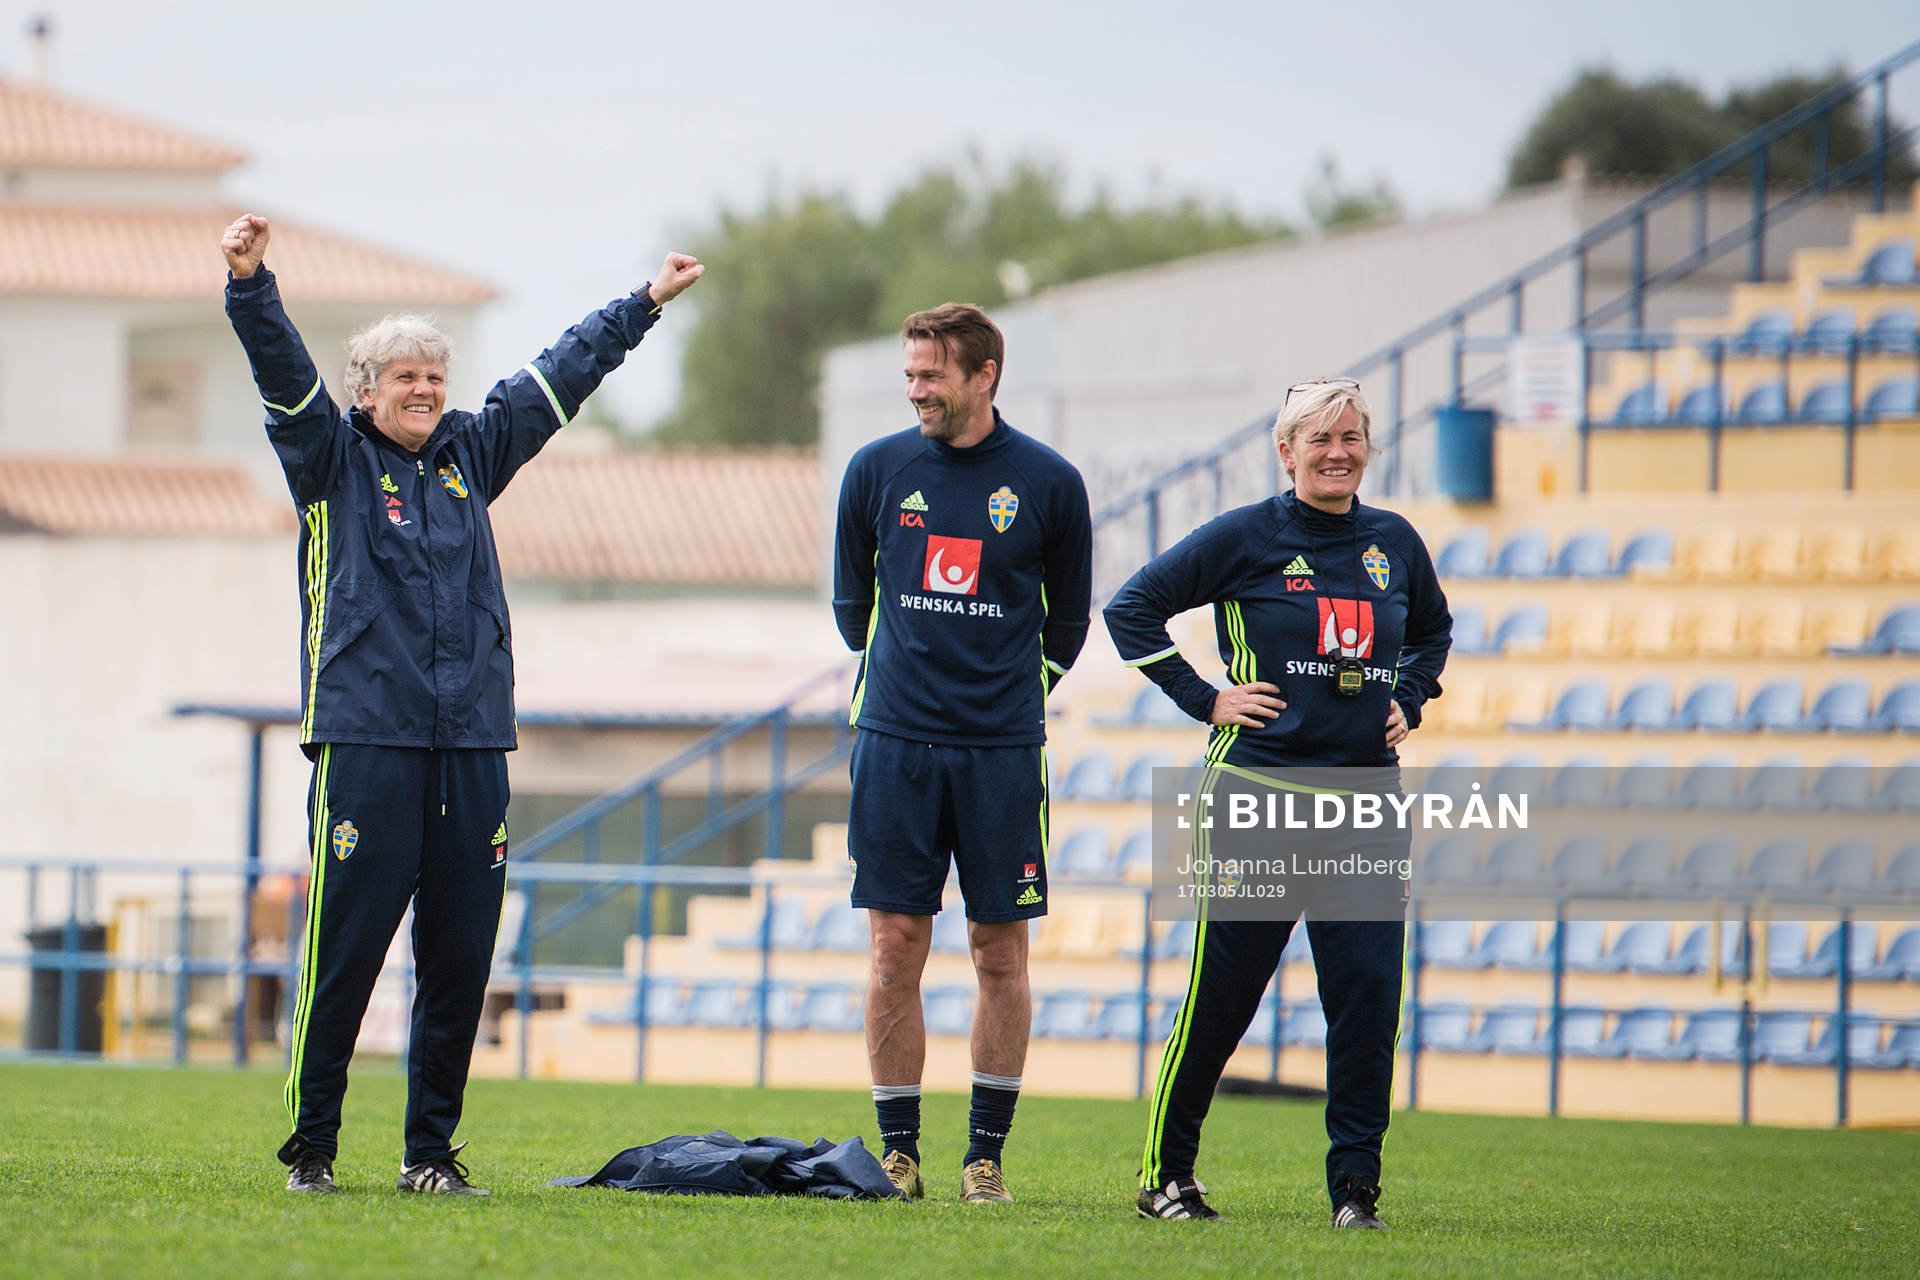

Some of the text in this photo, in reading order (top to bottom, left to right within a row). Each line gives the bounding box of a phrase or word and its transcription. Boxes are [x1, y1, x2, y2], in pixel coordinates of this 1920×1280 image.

[900, 501, 929, 512] adidas
[900, 512, 926, 528] ICA
[1283, 567, 1315, 576] adidas
[1286, 578, 1316, 592] ICA
[900, 594, 1003, 618] SVENSKA SPEL
[1286, 660, 1337, 677] SVENS
[1364, 666, 1393, 684] SPEL
